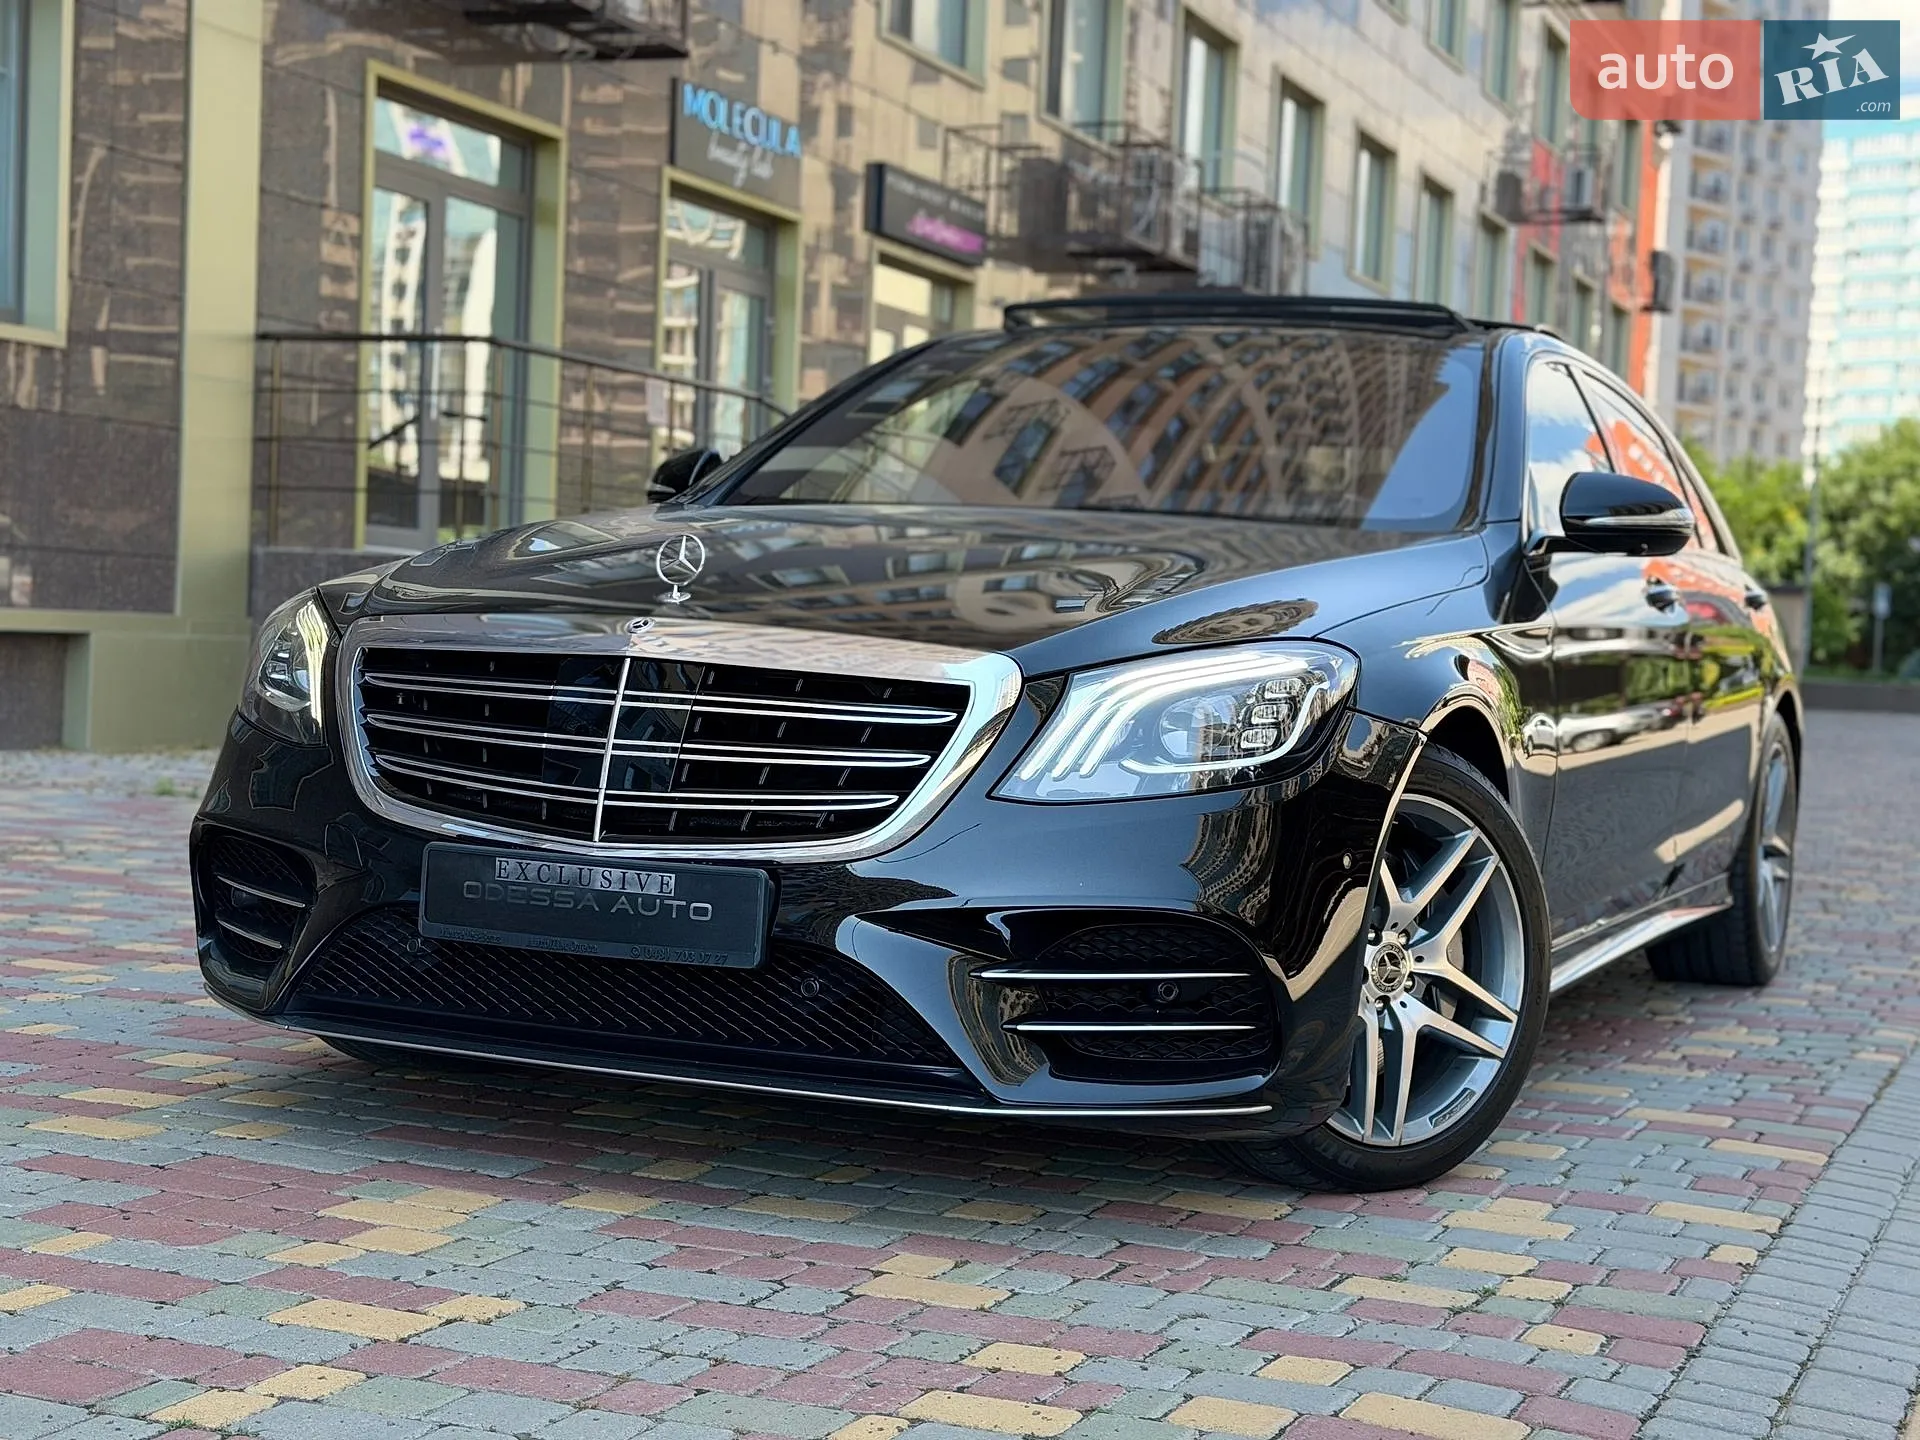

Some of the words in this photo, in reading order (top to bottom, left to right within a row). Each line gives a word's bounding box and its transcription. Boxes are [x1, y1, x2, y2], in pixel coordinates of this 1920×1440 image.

[497, 859, 674, 894] EXCLUSIVE
[463, 880, 599, 911] ODESSA
[610, 895, 713, 921] AUTO
